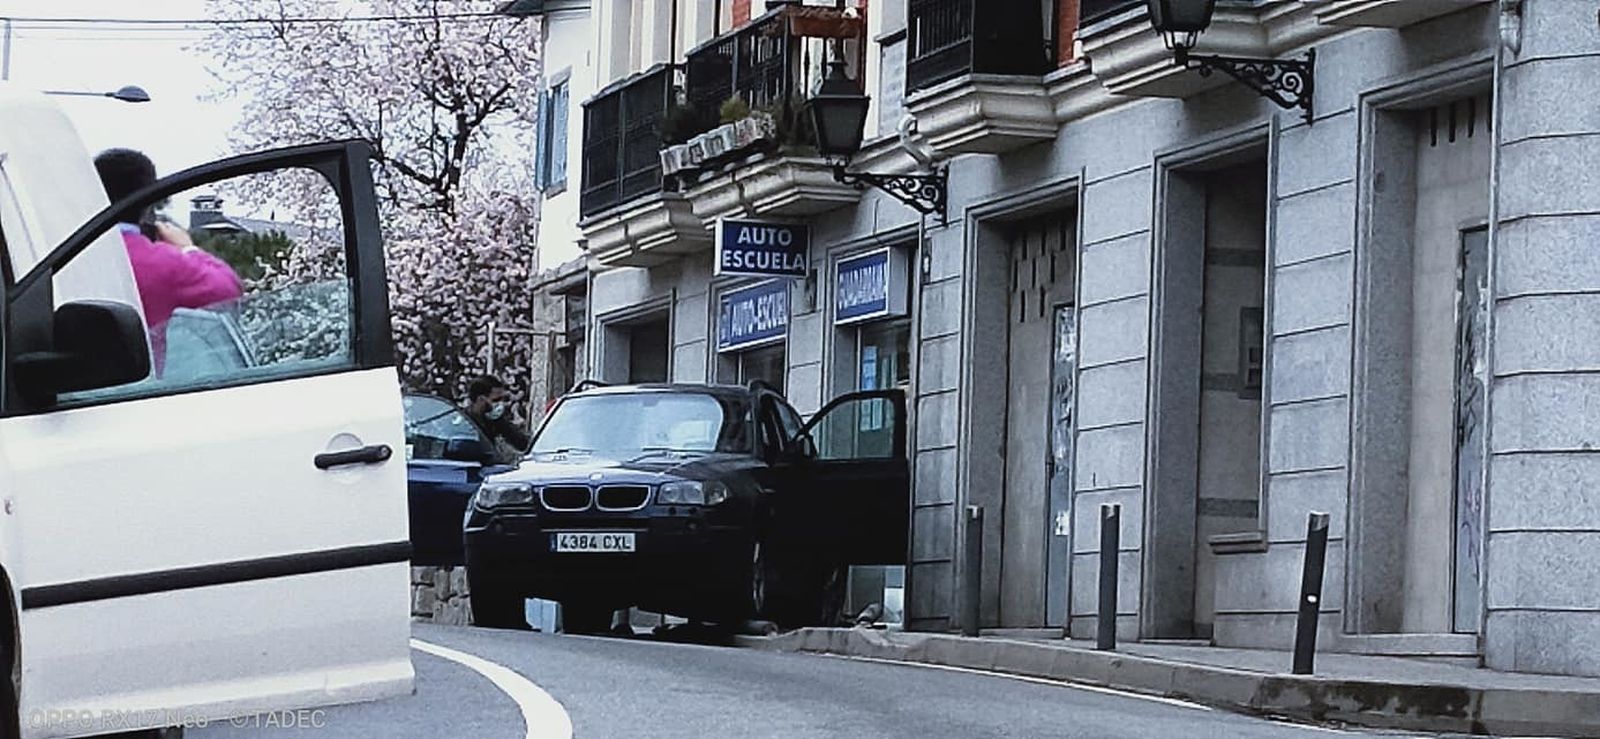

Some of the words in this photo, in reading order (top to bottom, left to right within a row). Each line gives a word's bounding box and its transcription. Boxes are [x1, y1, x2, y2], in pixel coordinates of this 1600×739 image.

[737, 226, 792, 246] AUTO
[721, 249, 805, 270] ESCUELA
[561, 535, 598, 549] 4384
[602, 535, 632, 549] CXL
